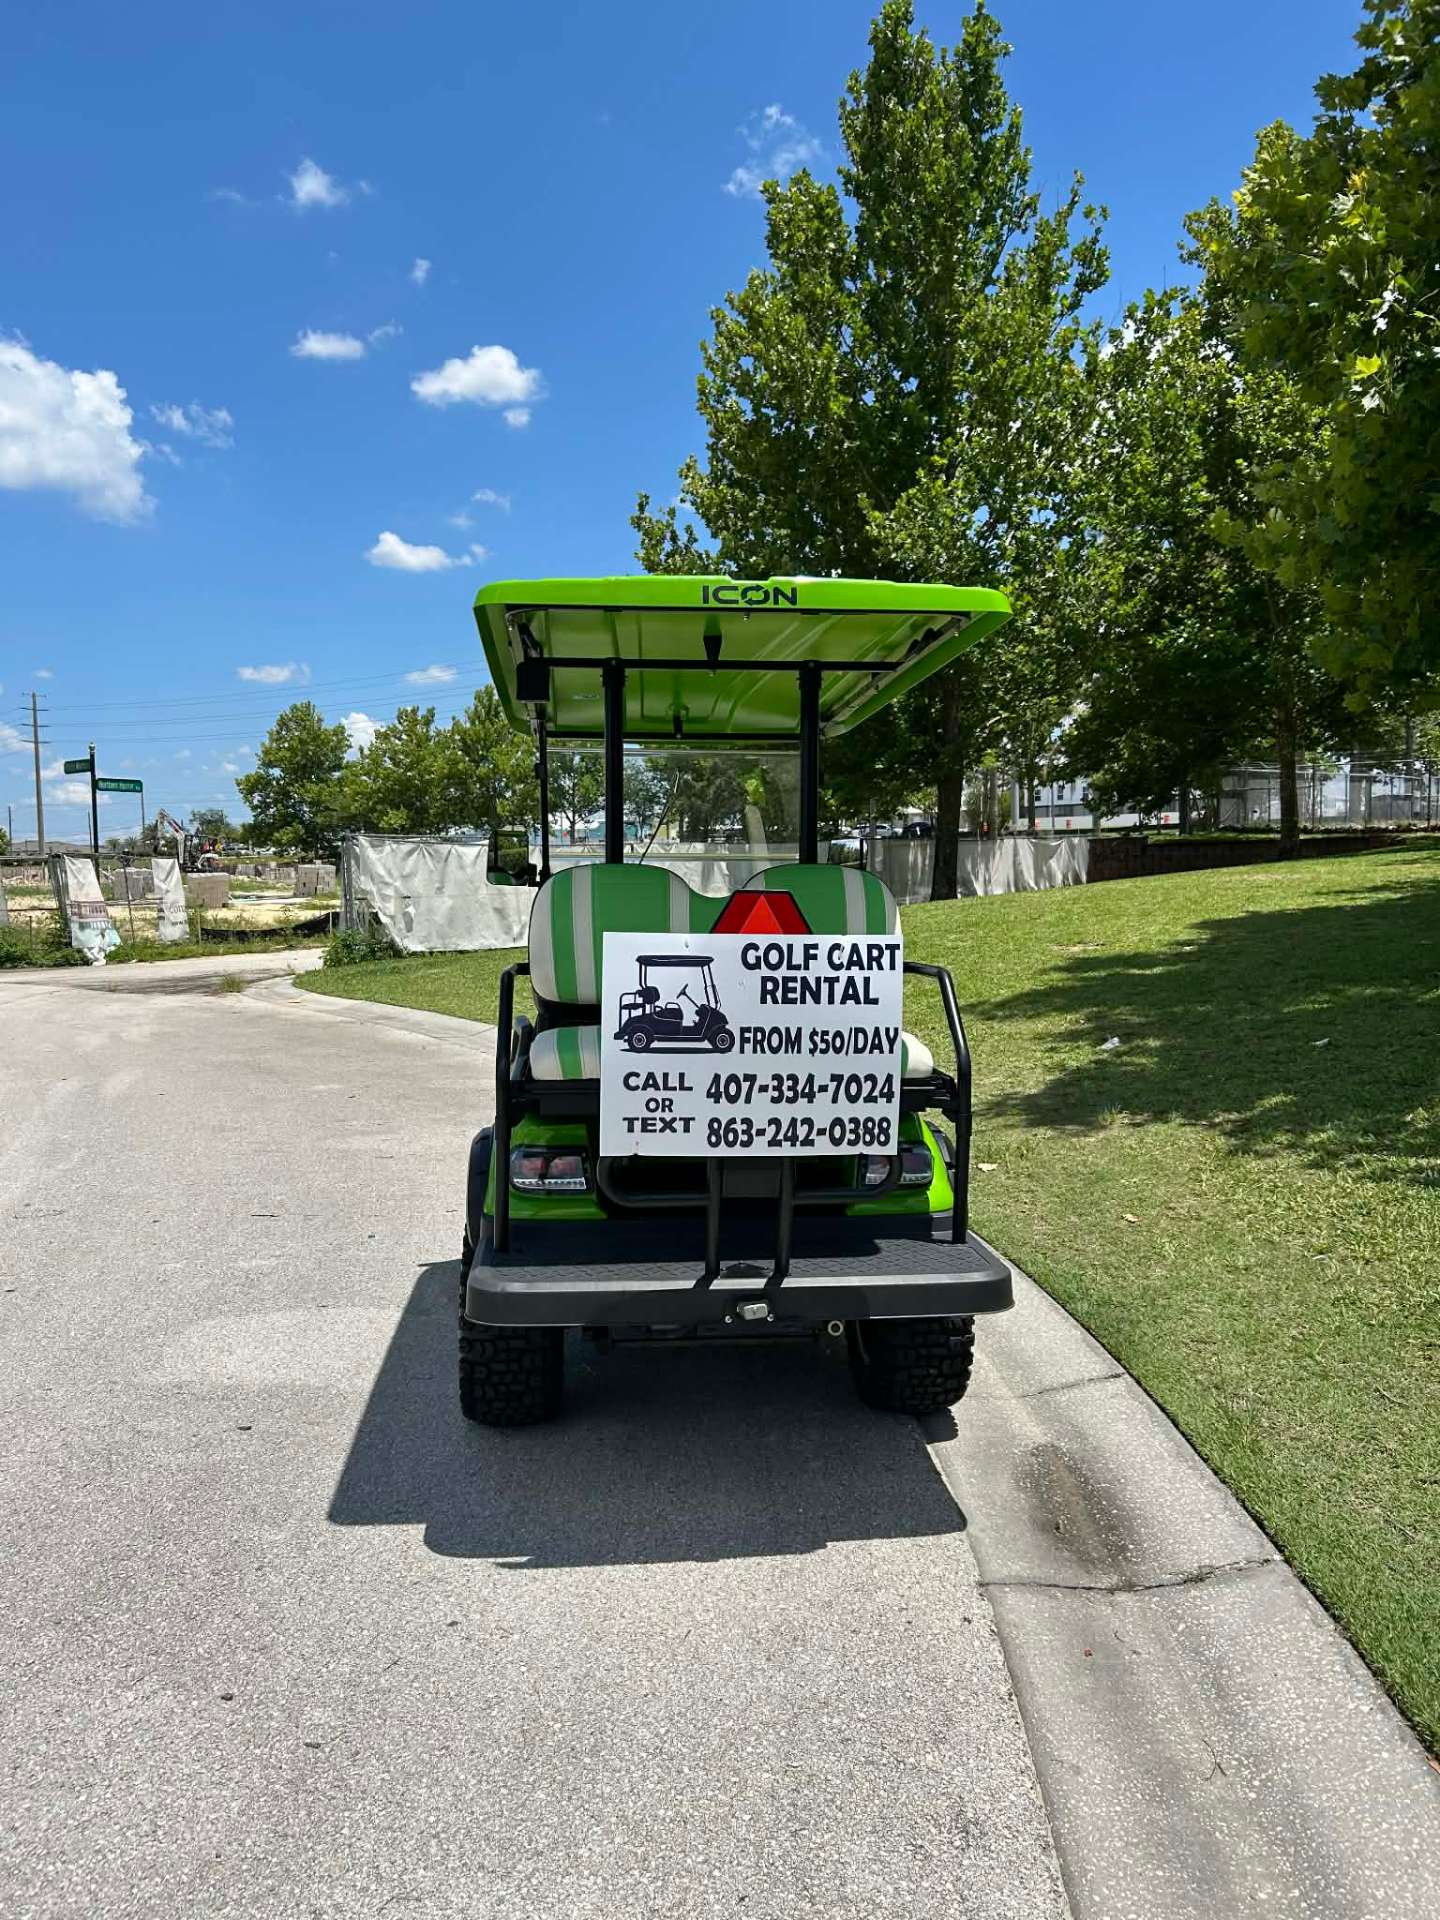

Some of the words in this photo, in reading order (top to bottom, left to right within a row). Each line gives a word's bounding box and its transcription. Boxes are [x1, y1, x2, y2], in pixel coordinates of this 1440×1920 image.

[702, 584, 798, 606] ICON
[741, 942, 819, 971] GOLF
[827, 942, 900, 971] CART
[760, 976, 879, 1005] RENTAL
[740, 1026, 802, 1054] FROM
[809, 1027, 898, 1056] $50/DAY
[623, 1072, 693, 1091] CALL
[706, 1073, 894, 1104] 407-334-7024
[645, 1098, 674, 1113] OR
[622, 1117, 695, 1133] TEXT
[707, 1117, 891, 1148] 863-242-0388
